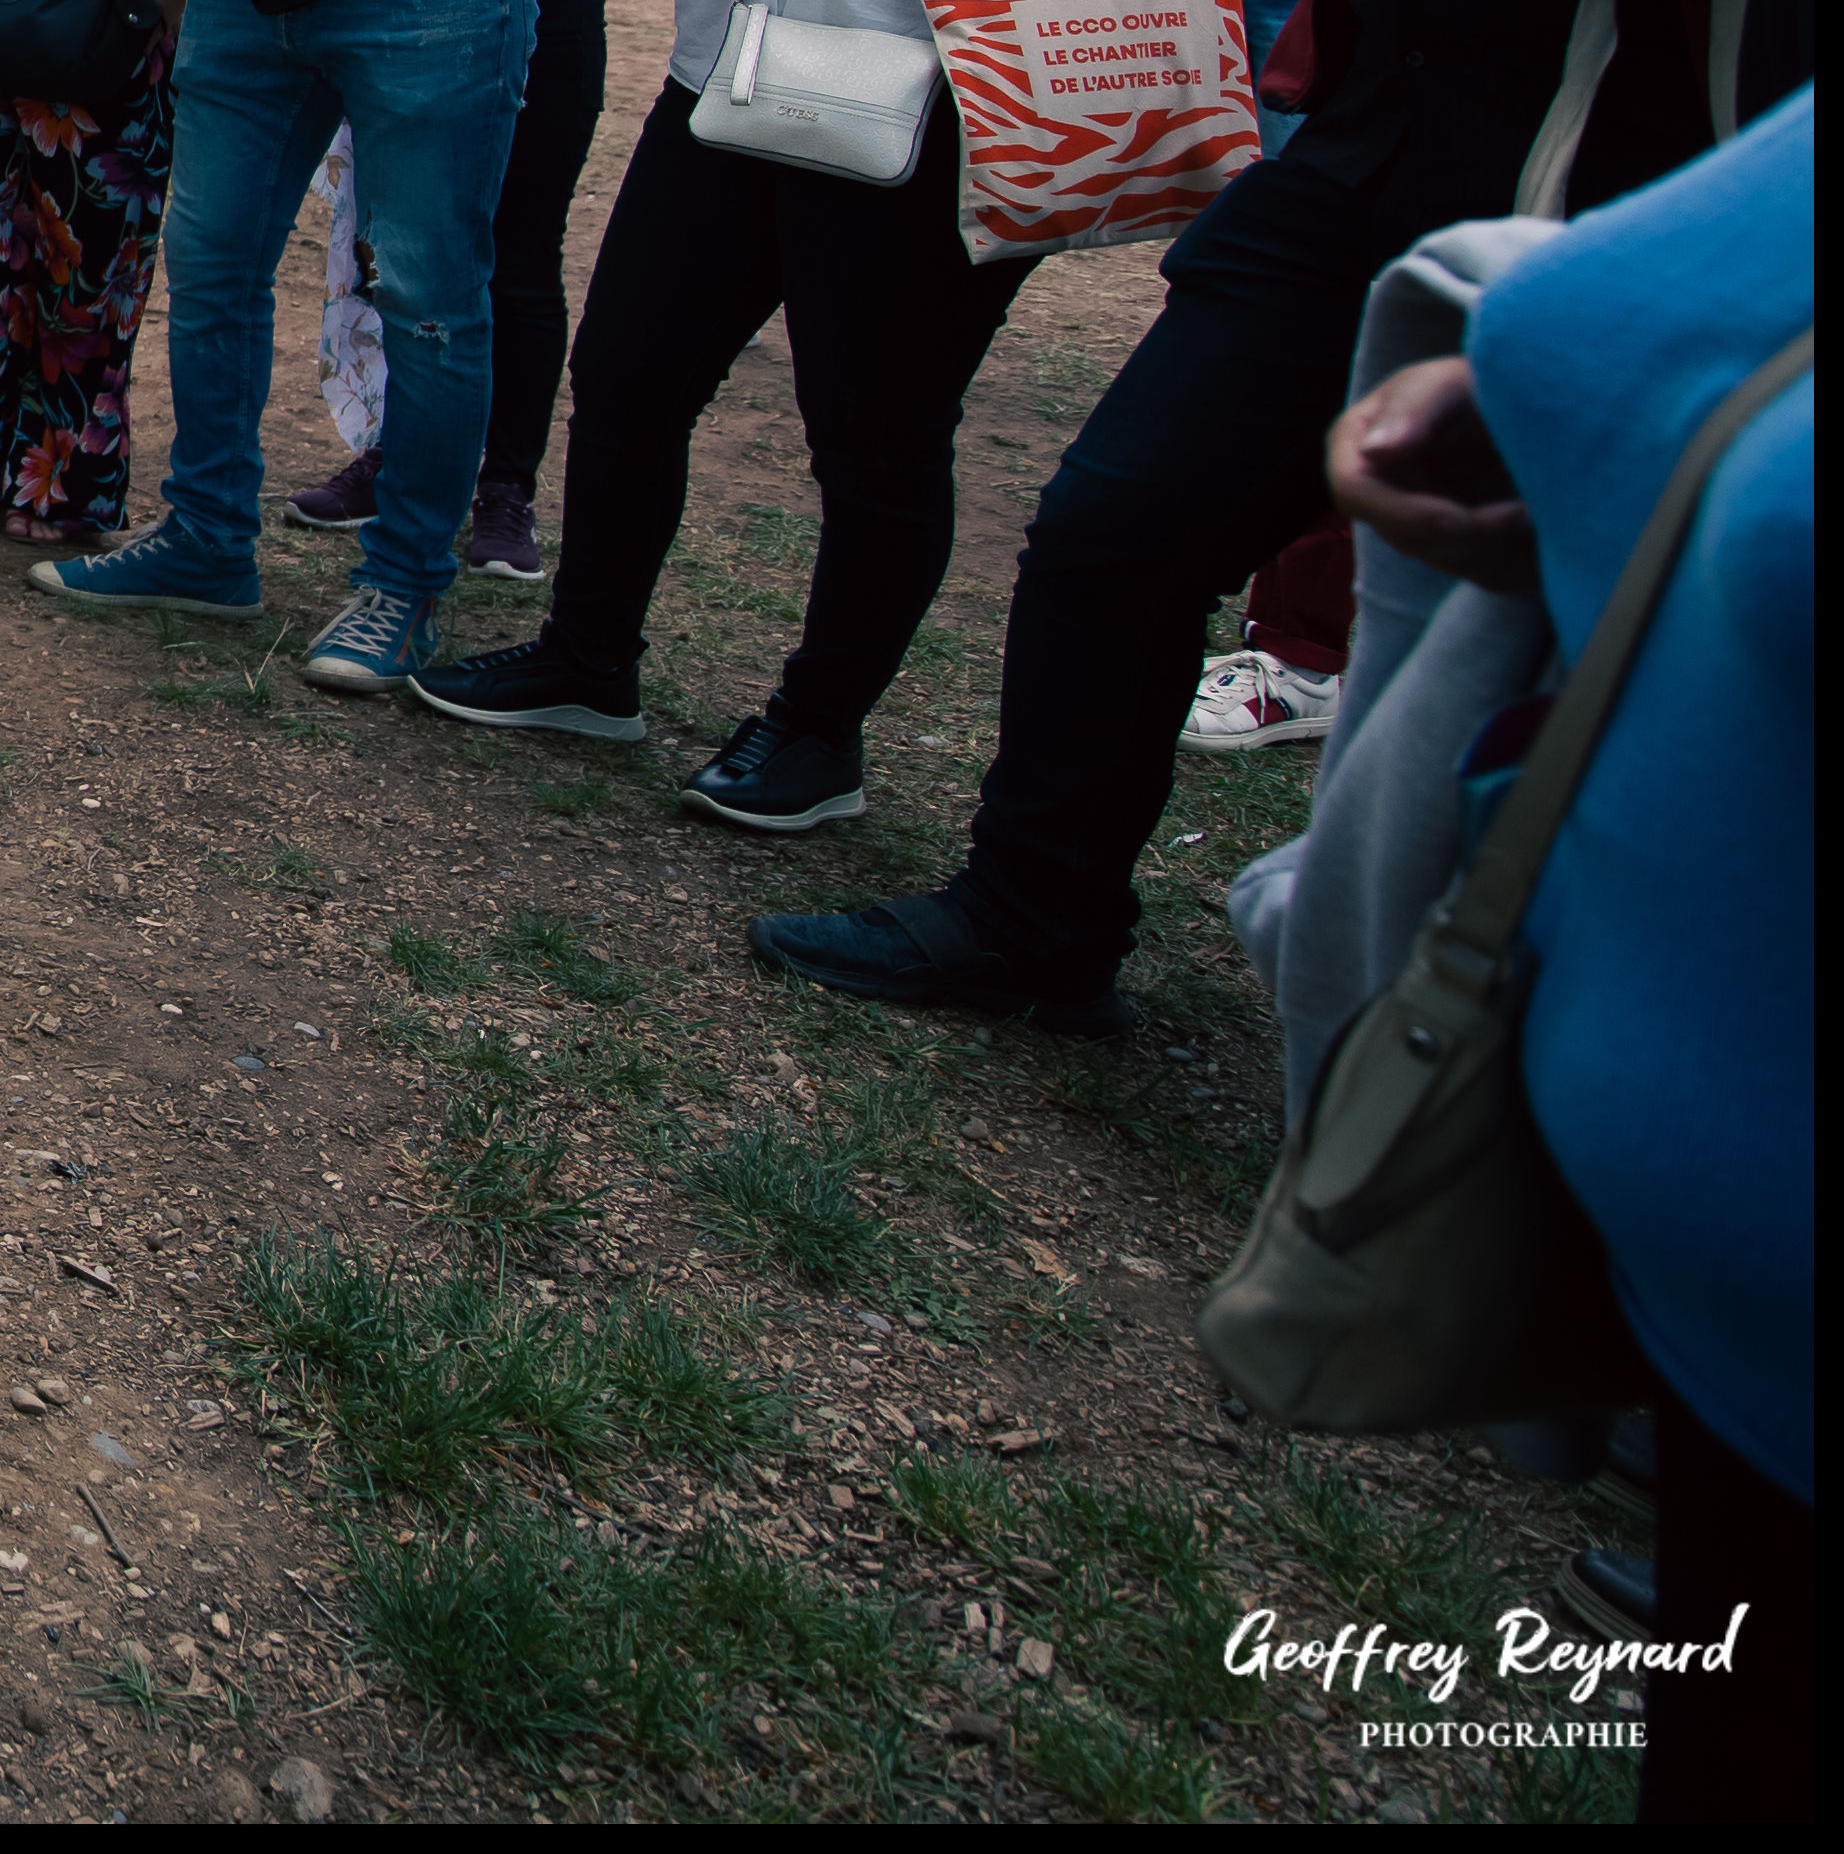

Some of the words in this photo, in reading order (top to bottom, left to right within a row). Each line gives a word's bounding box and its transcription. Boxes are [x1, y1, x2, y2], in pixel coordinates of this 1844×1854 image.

[1036, 21, 1062, 38] LE
[1065, 17, 1117, 35] CCO
[1121, 11, 1188, 30] OUVRE
[1043, 49, 1069, 66] LE
[1072, 41, 1177, 64] CHANTIER
[1050, 77, 1079, 94] DE
[1082, 71, 1158, 92] L'AUTRE
[1161, 69, 1202, 86] SOIE
[777, 105, 820, 122] GUESS
